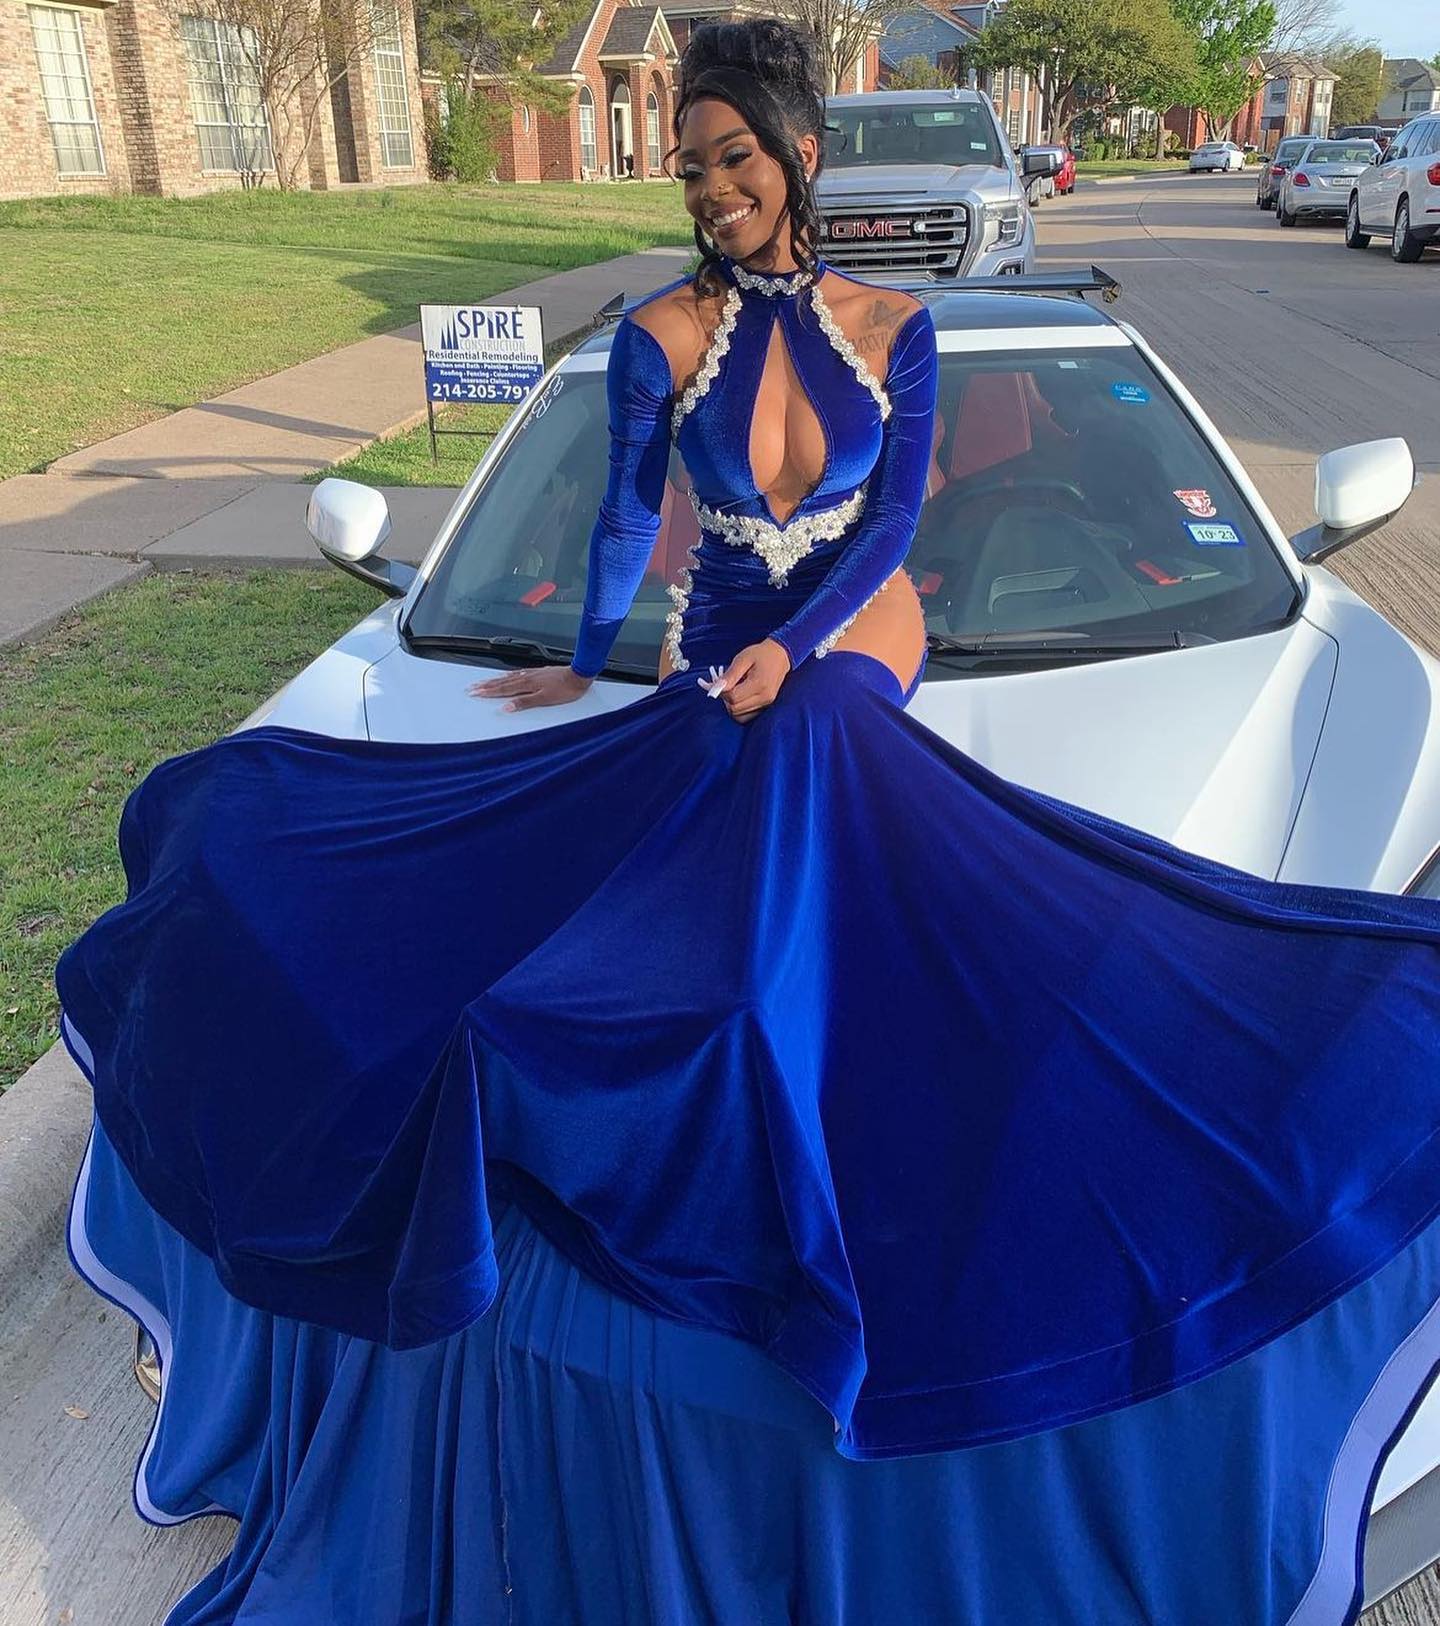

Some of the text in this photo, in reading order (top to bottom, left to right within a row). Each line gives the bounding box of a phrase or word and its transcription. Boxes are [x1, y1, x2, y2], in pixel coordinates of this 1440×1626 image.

[832, 221, 910, 238] GMC
[459, 340, 526, 351] CONSTRUCTION
[428, 350, 539, 363] Residential Remodeling
[483, 363, 509, 371] Painting
[512, 364, 538, 372] Flooring
[493, 371, 530, 379] Countertops
[432, 384, 530, 399] 214-205-791
[1197, 530, 1236, 540] 10 23
